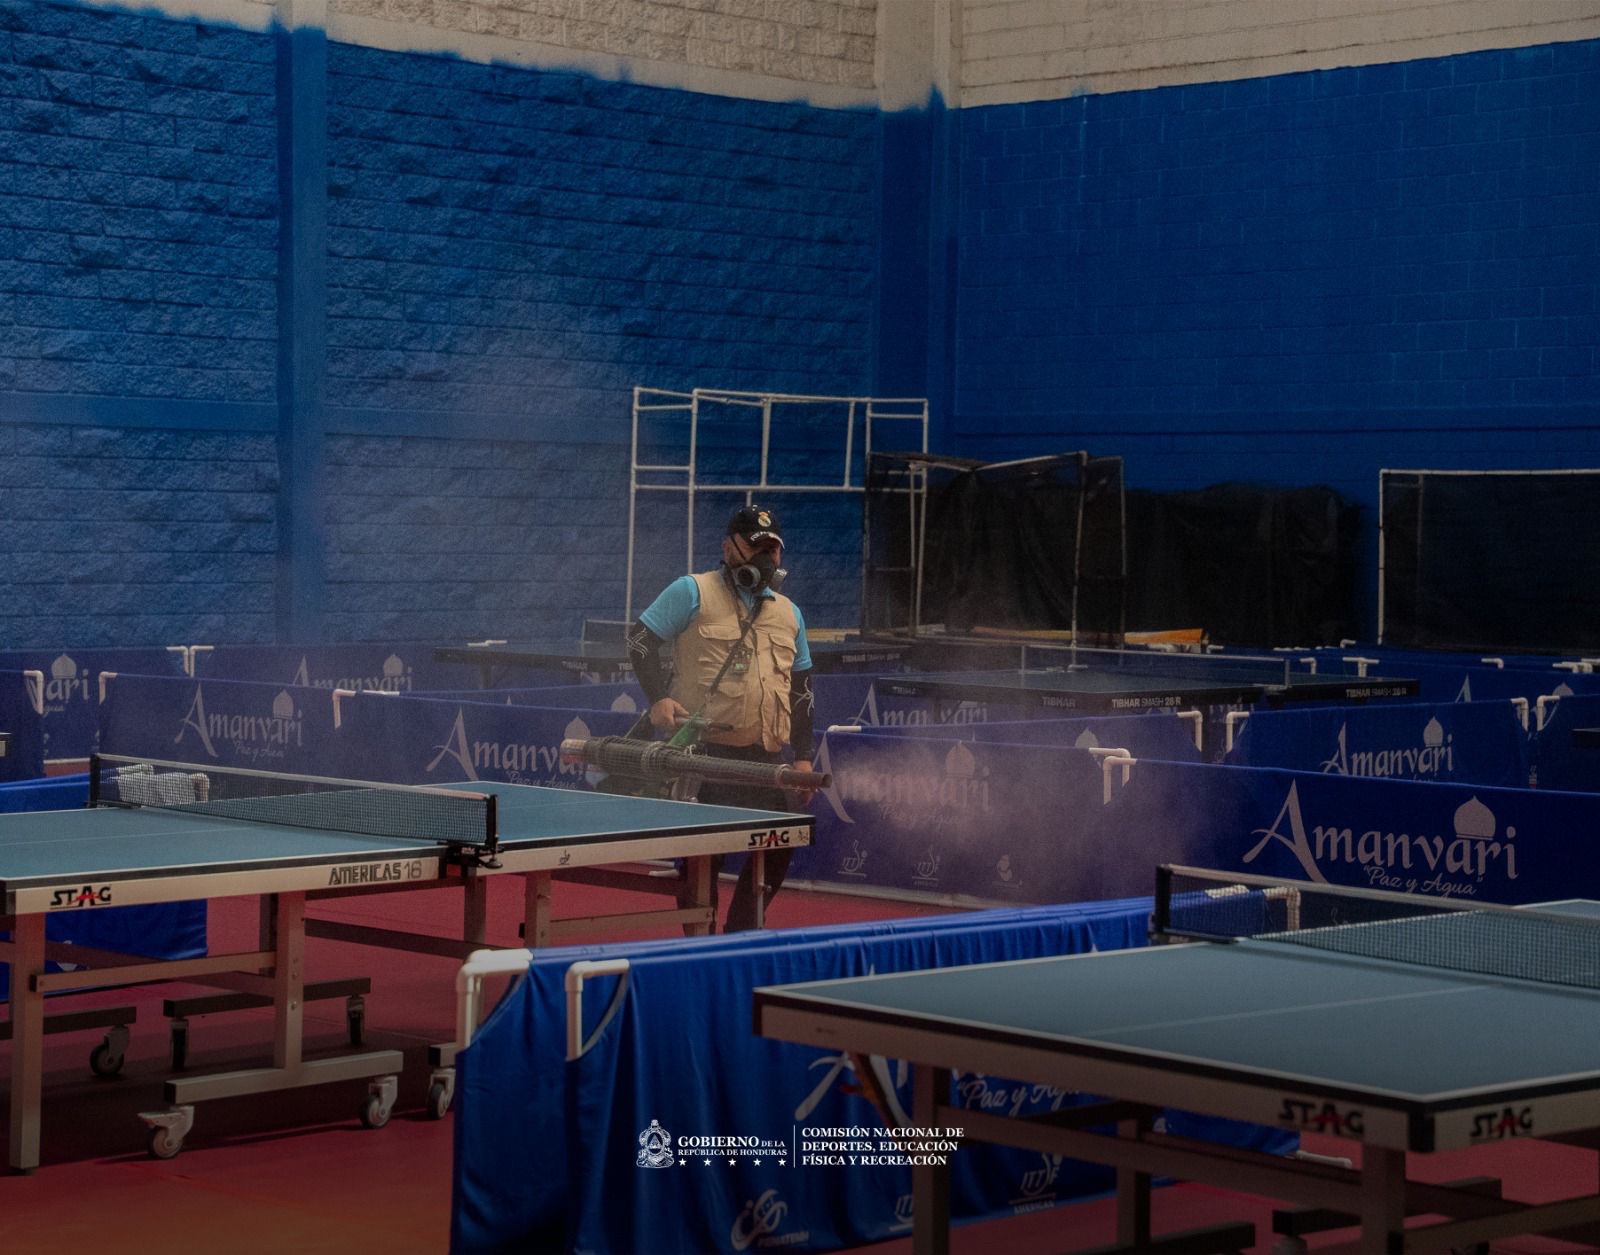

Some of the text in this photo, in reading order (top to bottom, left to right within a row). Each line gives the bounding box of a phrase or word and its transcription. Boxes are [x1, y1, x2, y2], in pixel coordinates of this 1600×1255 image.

[1112, 698, 1141, 709] TIBHAR
[174, 682, 304, 758] Amanvari
[1320, 720, 1453, 777] Amanvari
[749, 829, 790, 848] STAG
[1241, 778, 1519, 883] Amanvari
[328, 862, 402, 886] AMERICAS
[1405, 878, 1418, 893] y
[51, 885, 112, 907] STAG
[1278, 1099, 1365, 1136] STAG
[1470, 1106, 1533, 1139] STAG
